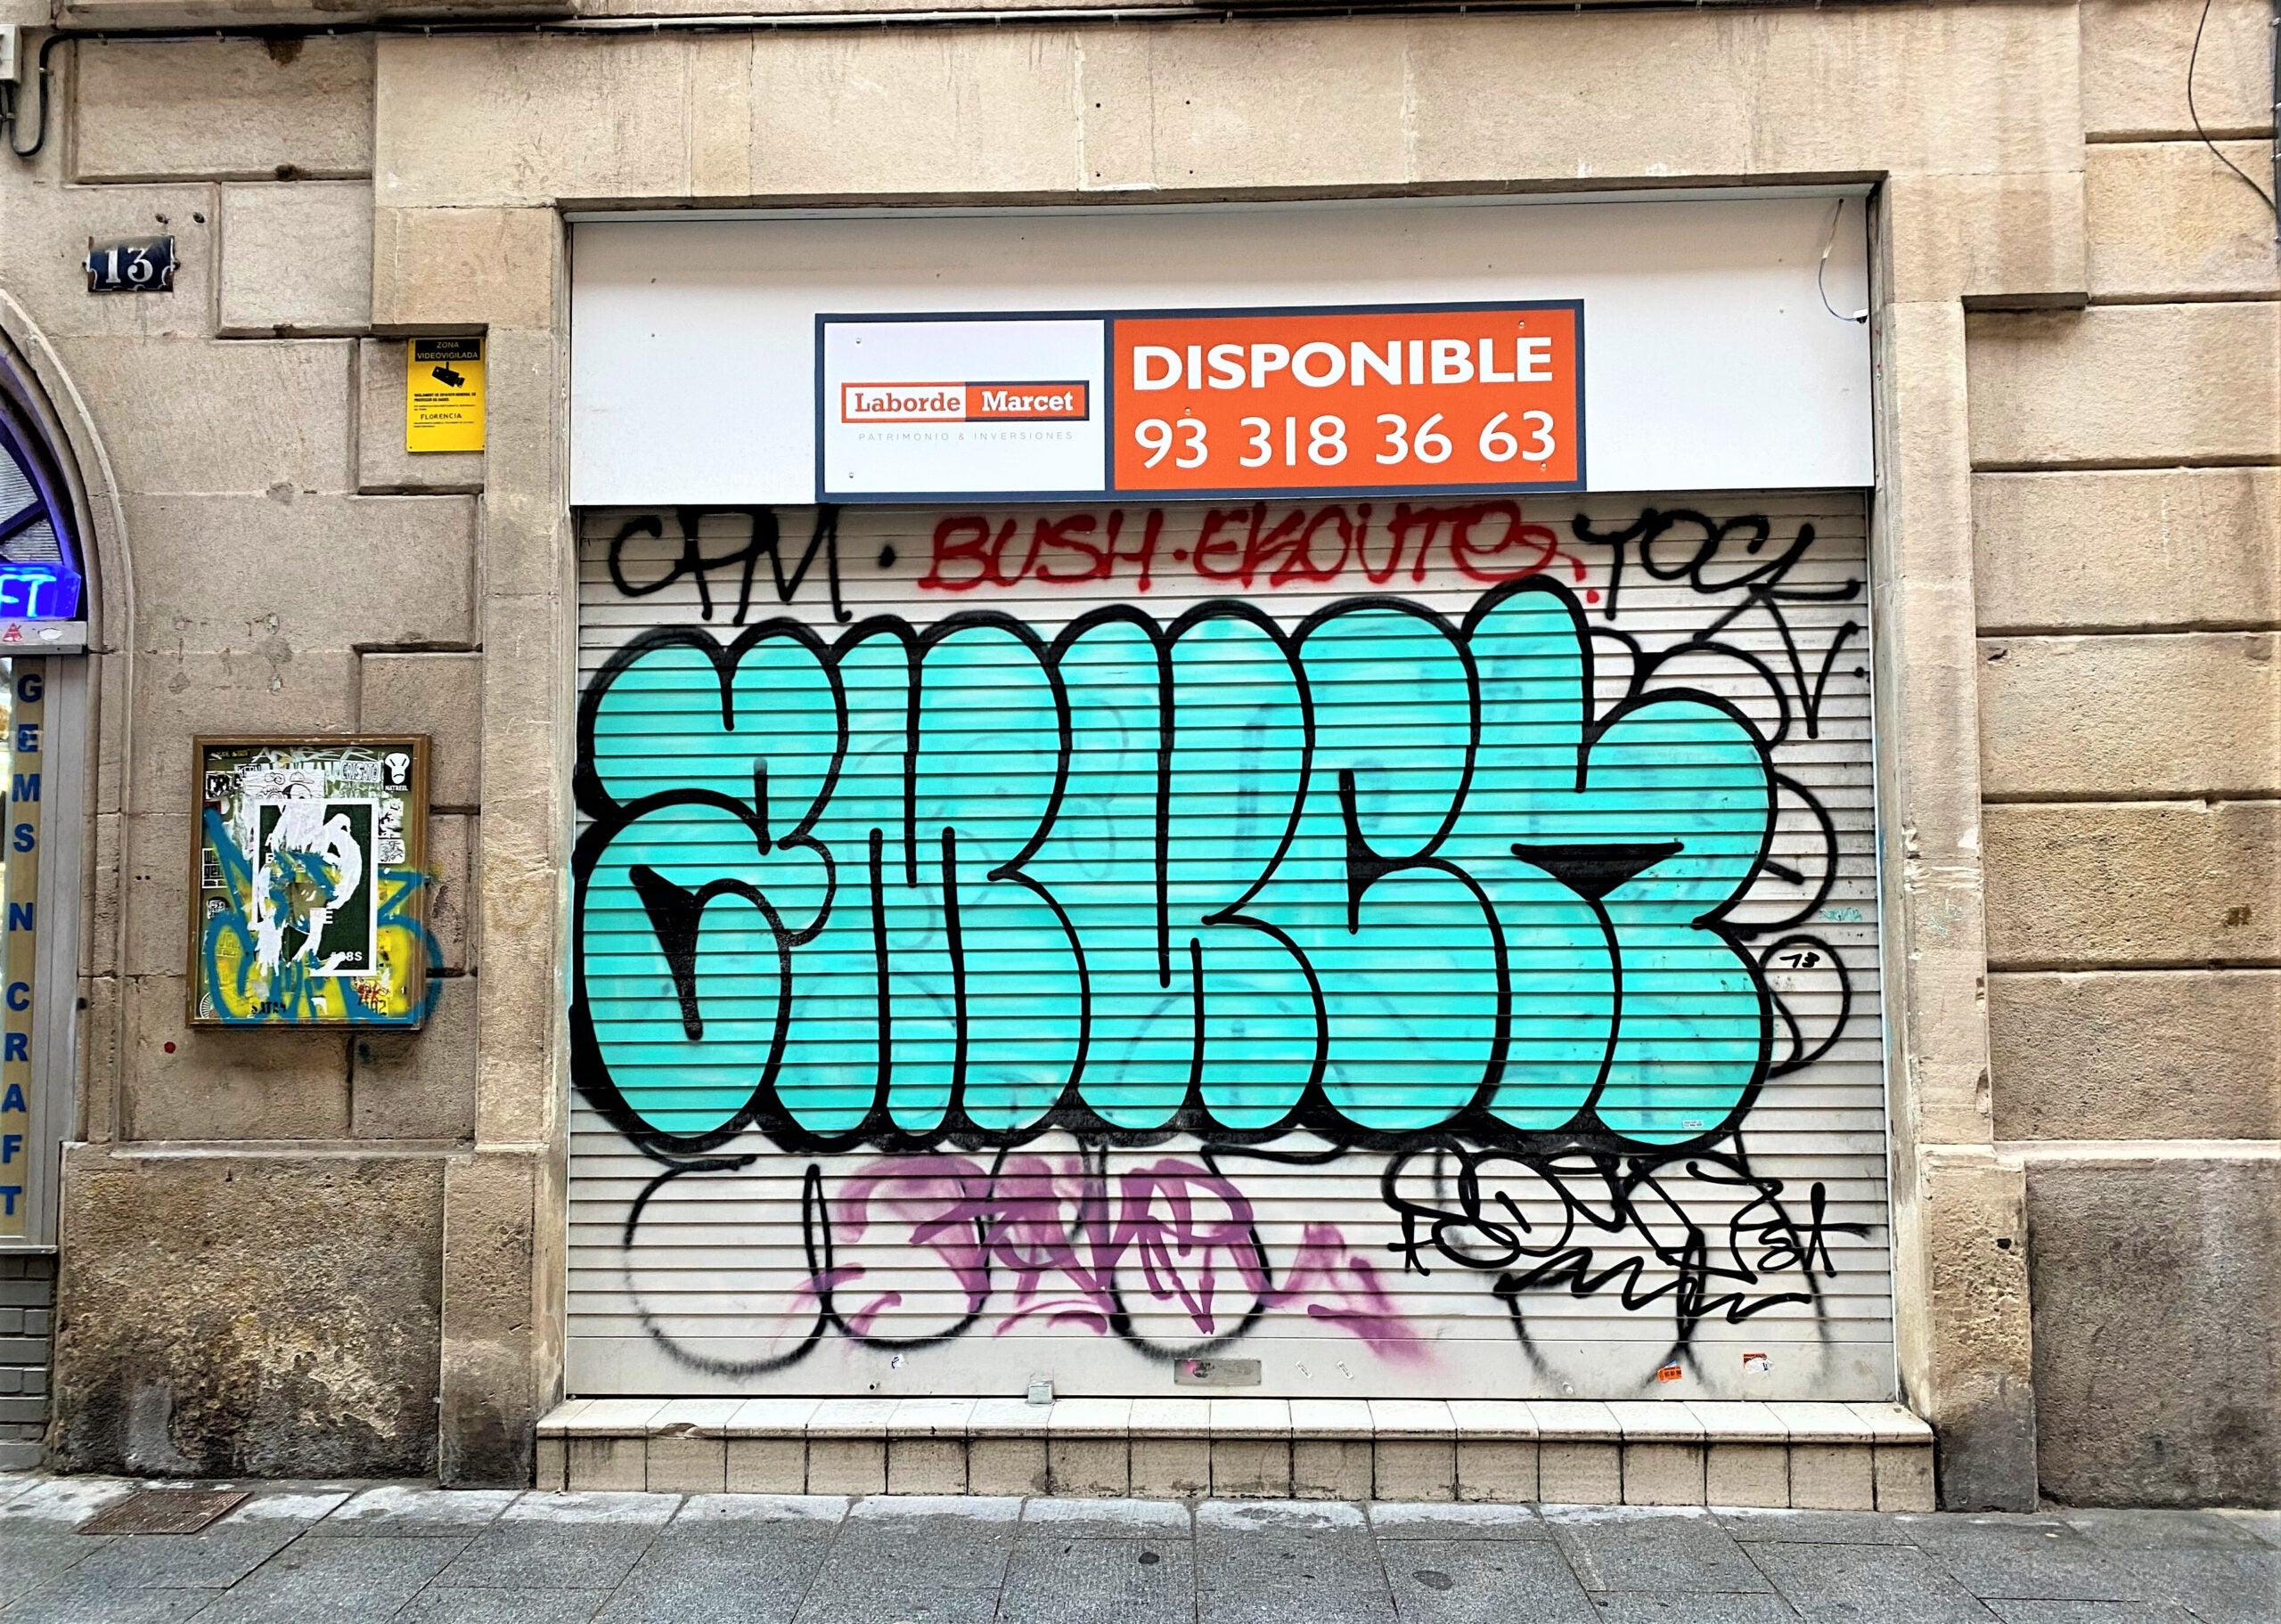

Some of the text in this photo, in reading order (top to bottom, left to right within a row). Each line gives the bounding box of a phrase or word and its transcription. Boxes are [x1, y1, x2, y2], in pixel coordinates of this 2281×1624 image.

[105, 244, 153, 283] 13
[417, 351, 478, 360] VIDEOVIGILADA
[1132, 337, 1553, 390] DISPONIBLE
[420, 412, 462, 420] FLORENCIA
[854, 390, 1074, 412] Laborde Marcet
[858, 431, 1074, 442] PATRIMONIO & INVERSIONES
[1134, 410, 1556, 469] 93 318 36 63
[0, 673, 43, 1216] GEMS N CRAFT
